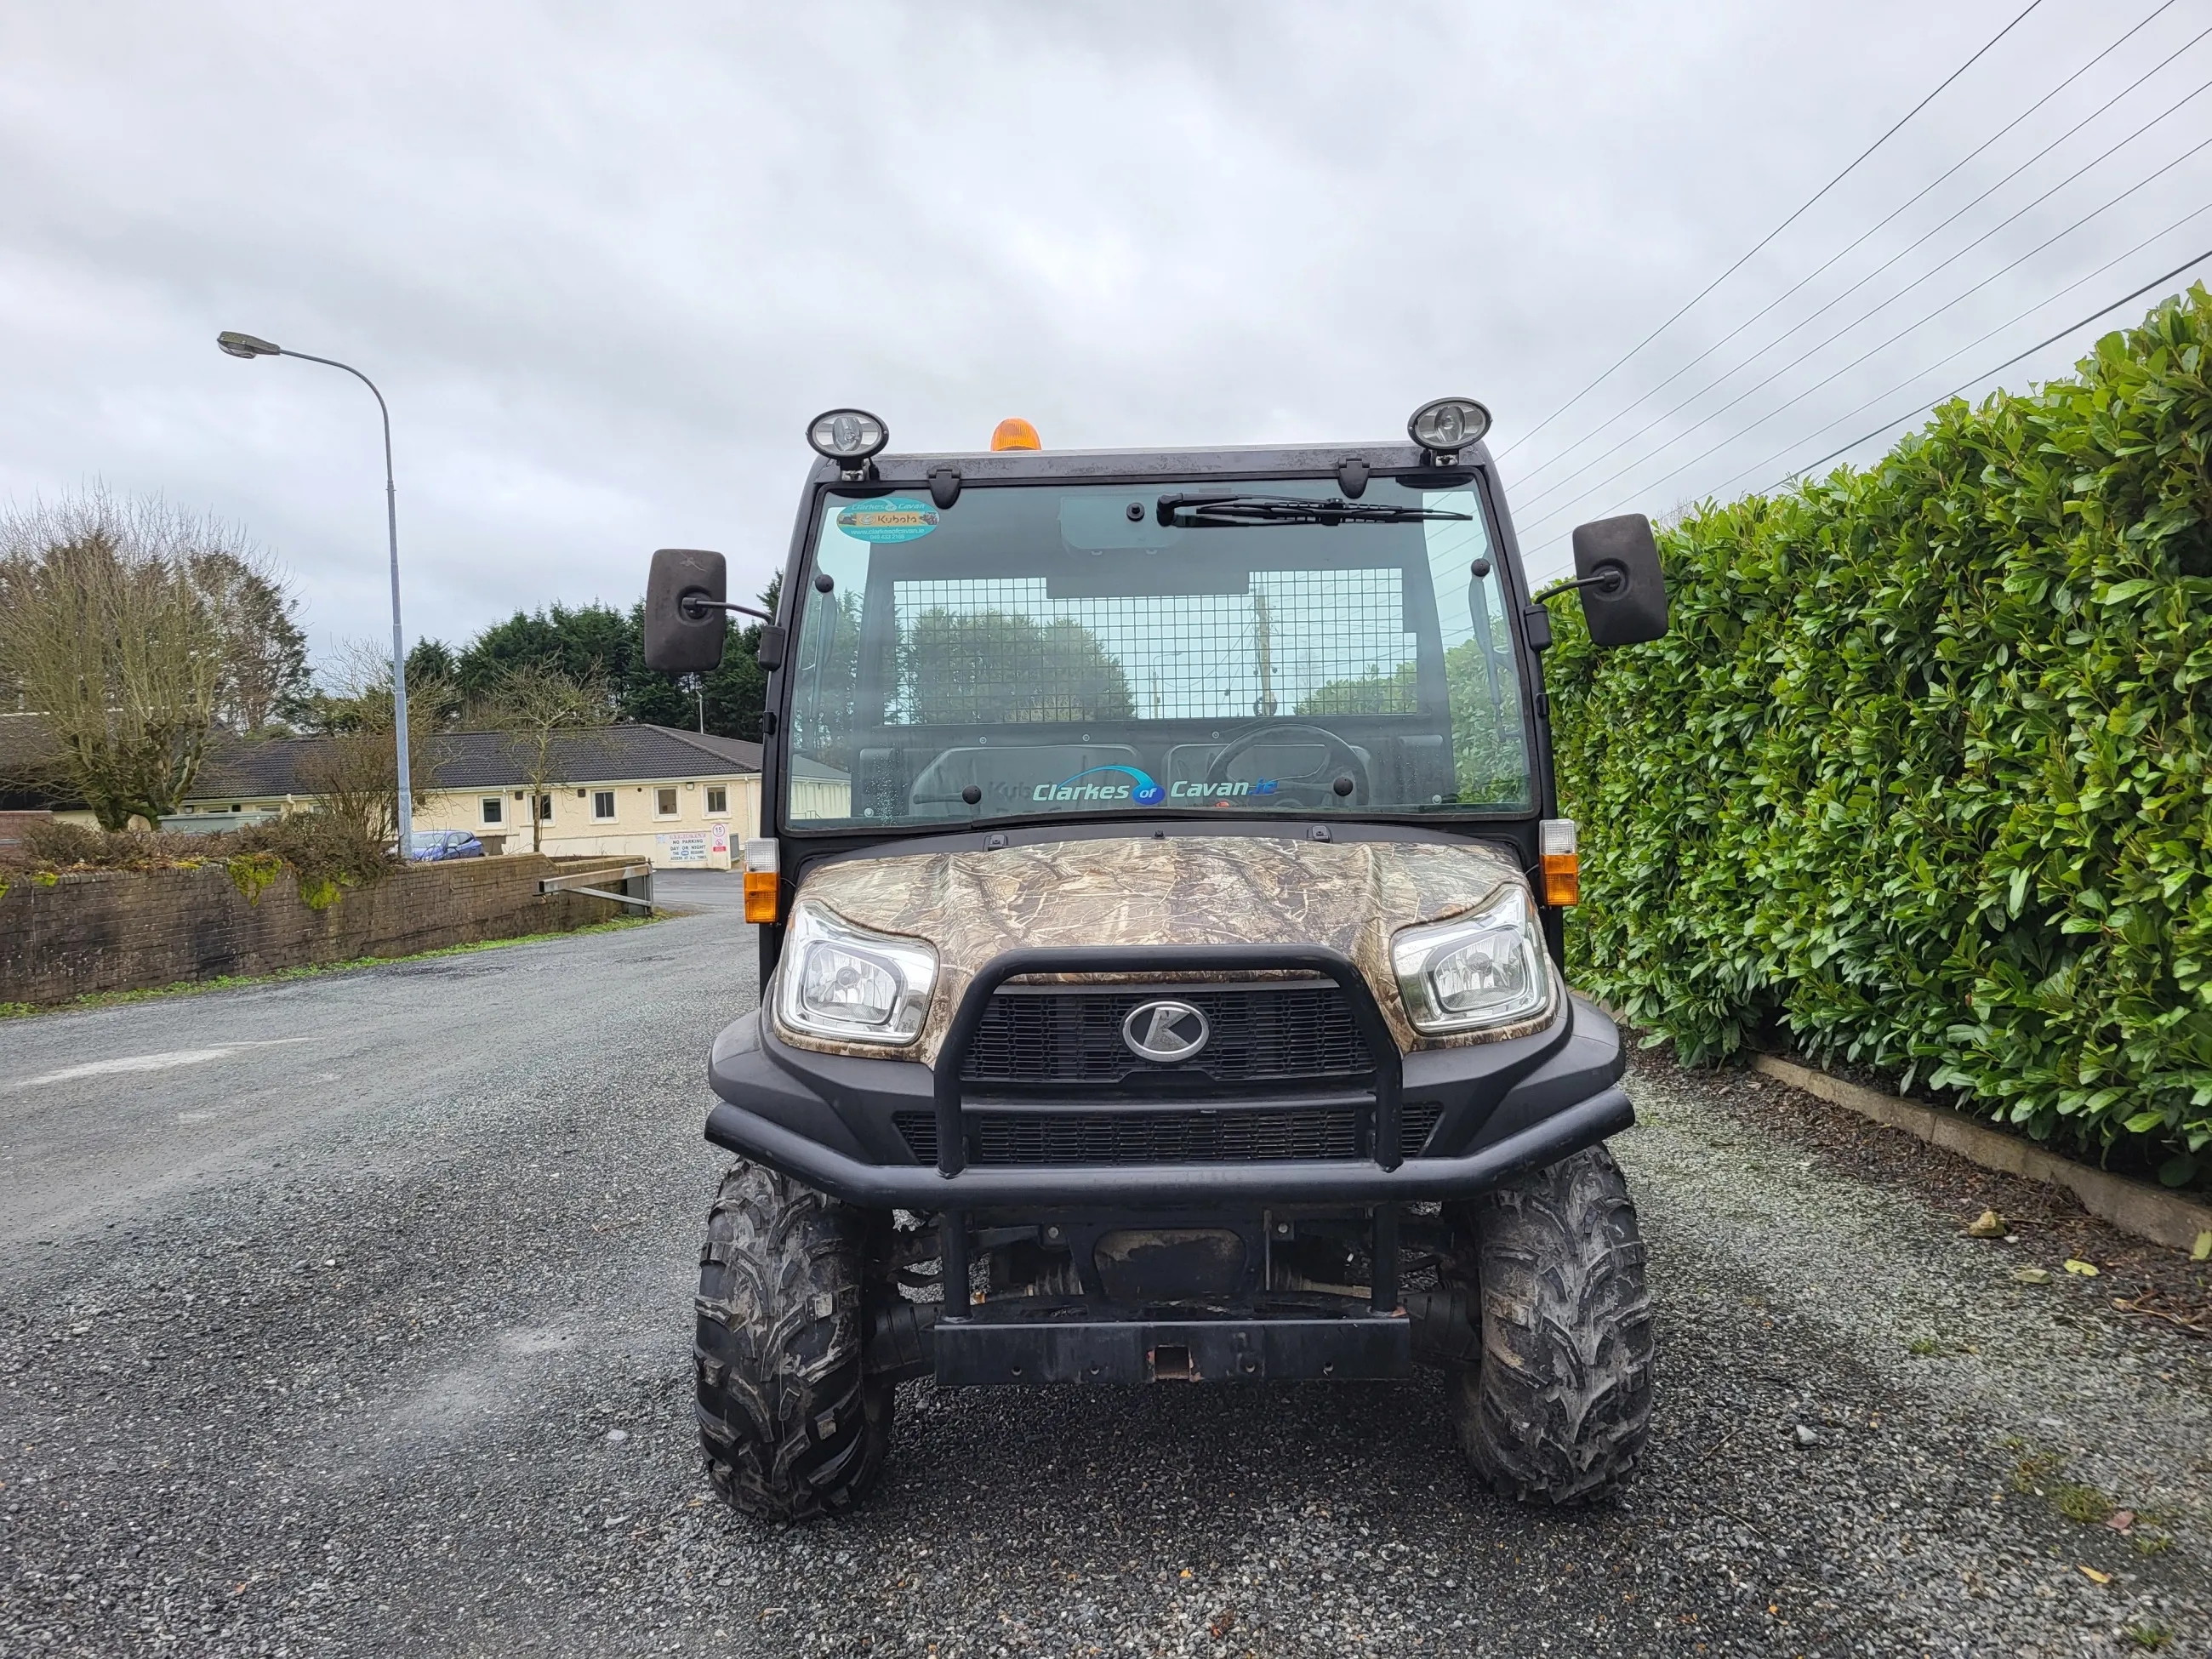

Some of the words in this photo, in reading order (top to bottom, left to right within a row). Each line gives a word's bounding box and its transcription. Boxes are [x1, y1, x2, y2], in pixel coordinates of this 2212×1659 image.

[878, 514, 917, 524] Kubota
[1033, 784, 1130, 801] Clarkes
[1139, 788, 1156, 799] of
